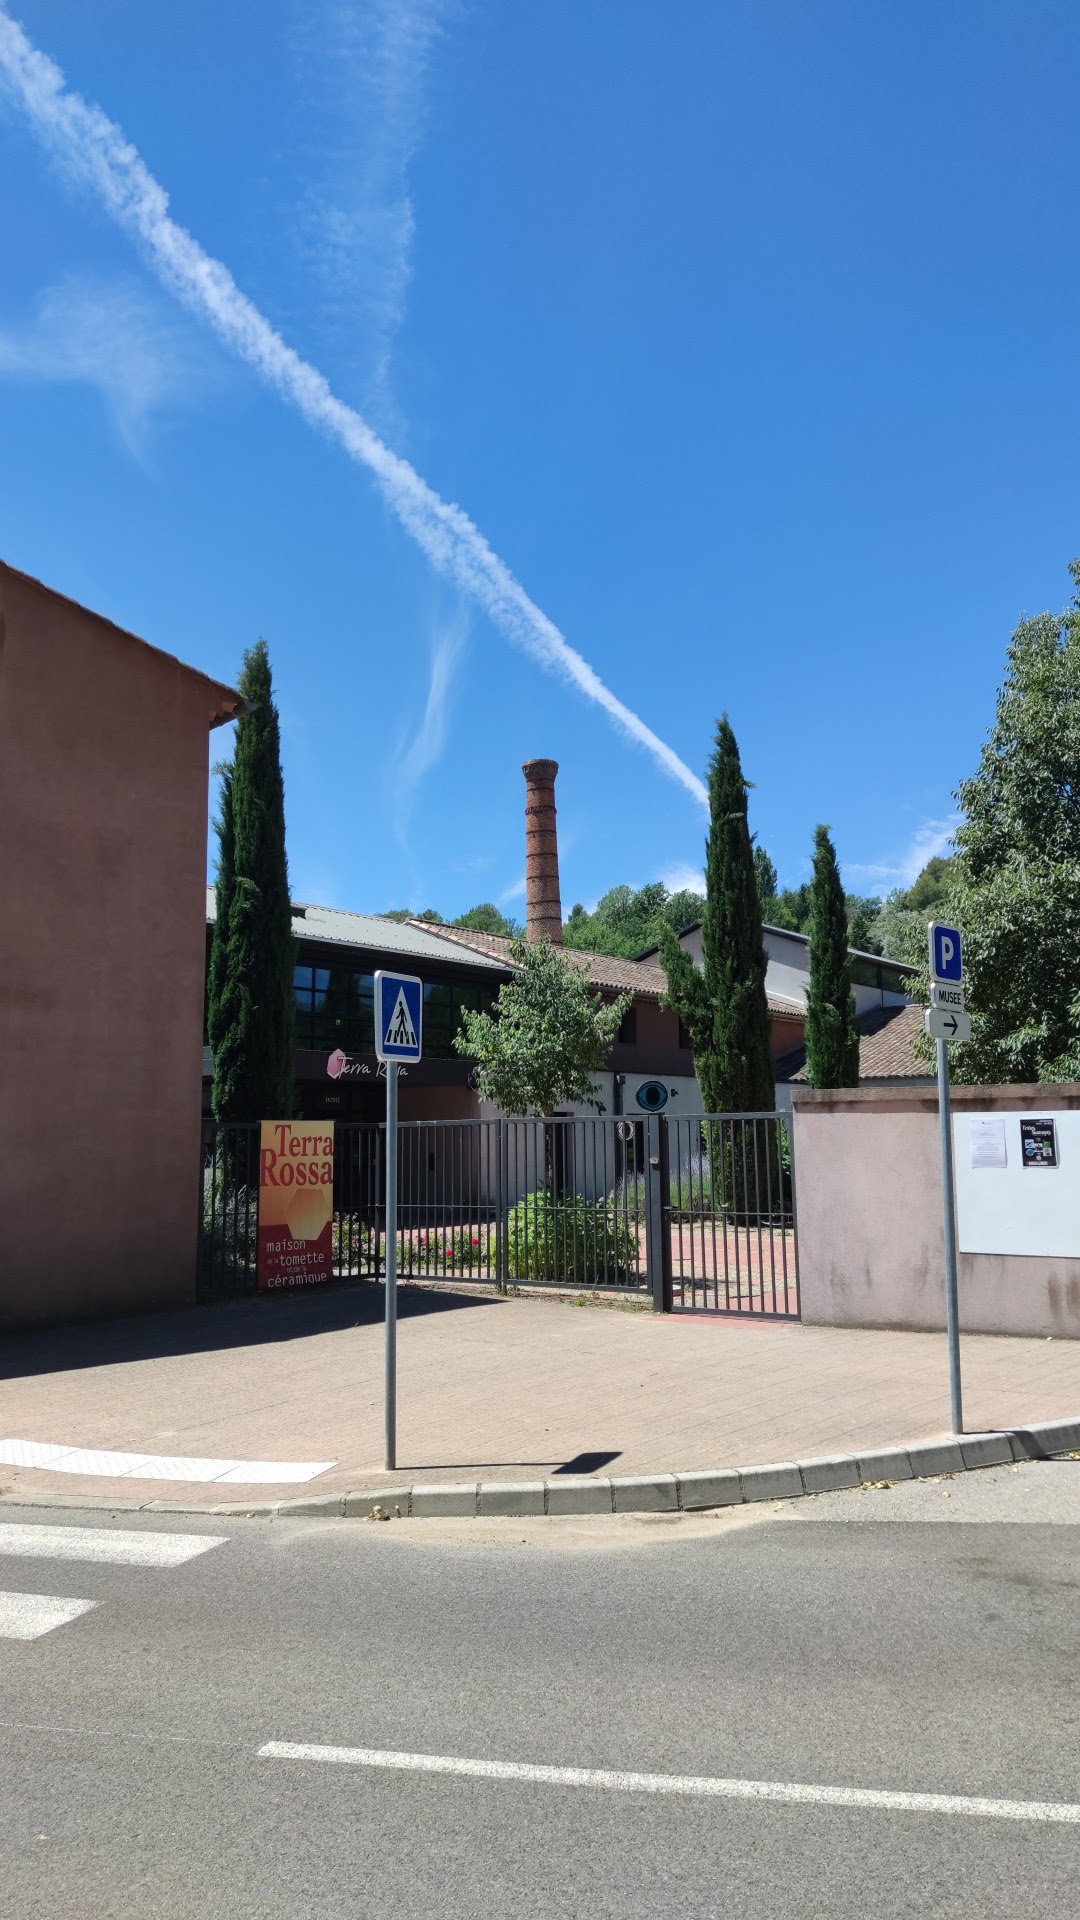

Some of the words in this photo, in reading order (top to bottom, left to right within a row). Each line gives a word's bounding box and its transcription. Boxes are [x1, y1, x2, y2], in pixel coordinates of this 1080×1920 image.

[941, 935, 954, 970] P
[938, 989, 961, 1005] MUSEE
[337, 1056, 371, 1079] Terra
[274, 1124, 334, 1157] Terra
[260, 1148, 334, 1187] Rossa
[266, 1239, 306, 1252] maison
[279, 1251, 325, 1267] tomette
[267, 1272, 328, 1288] céramique
